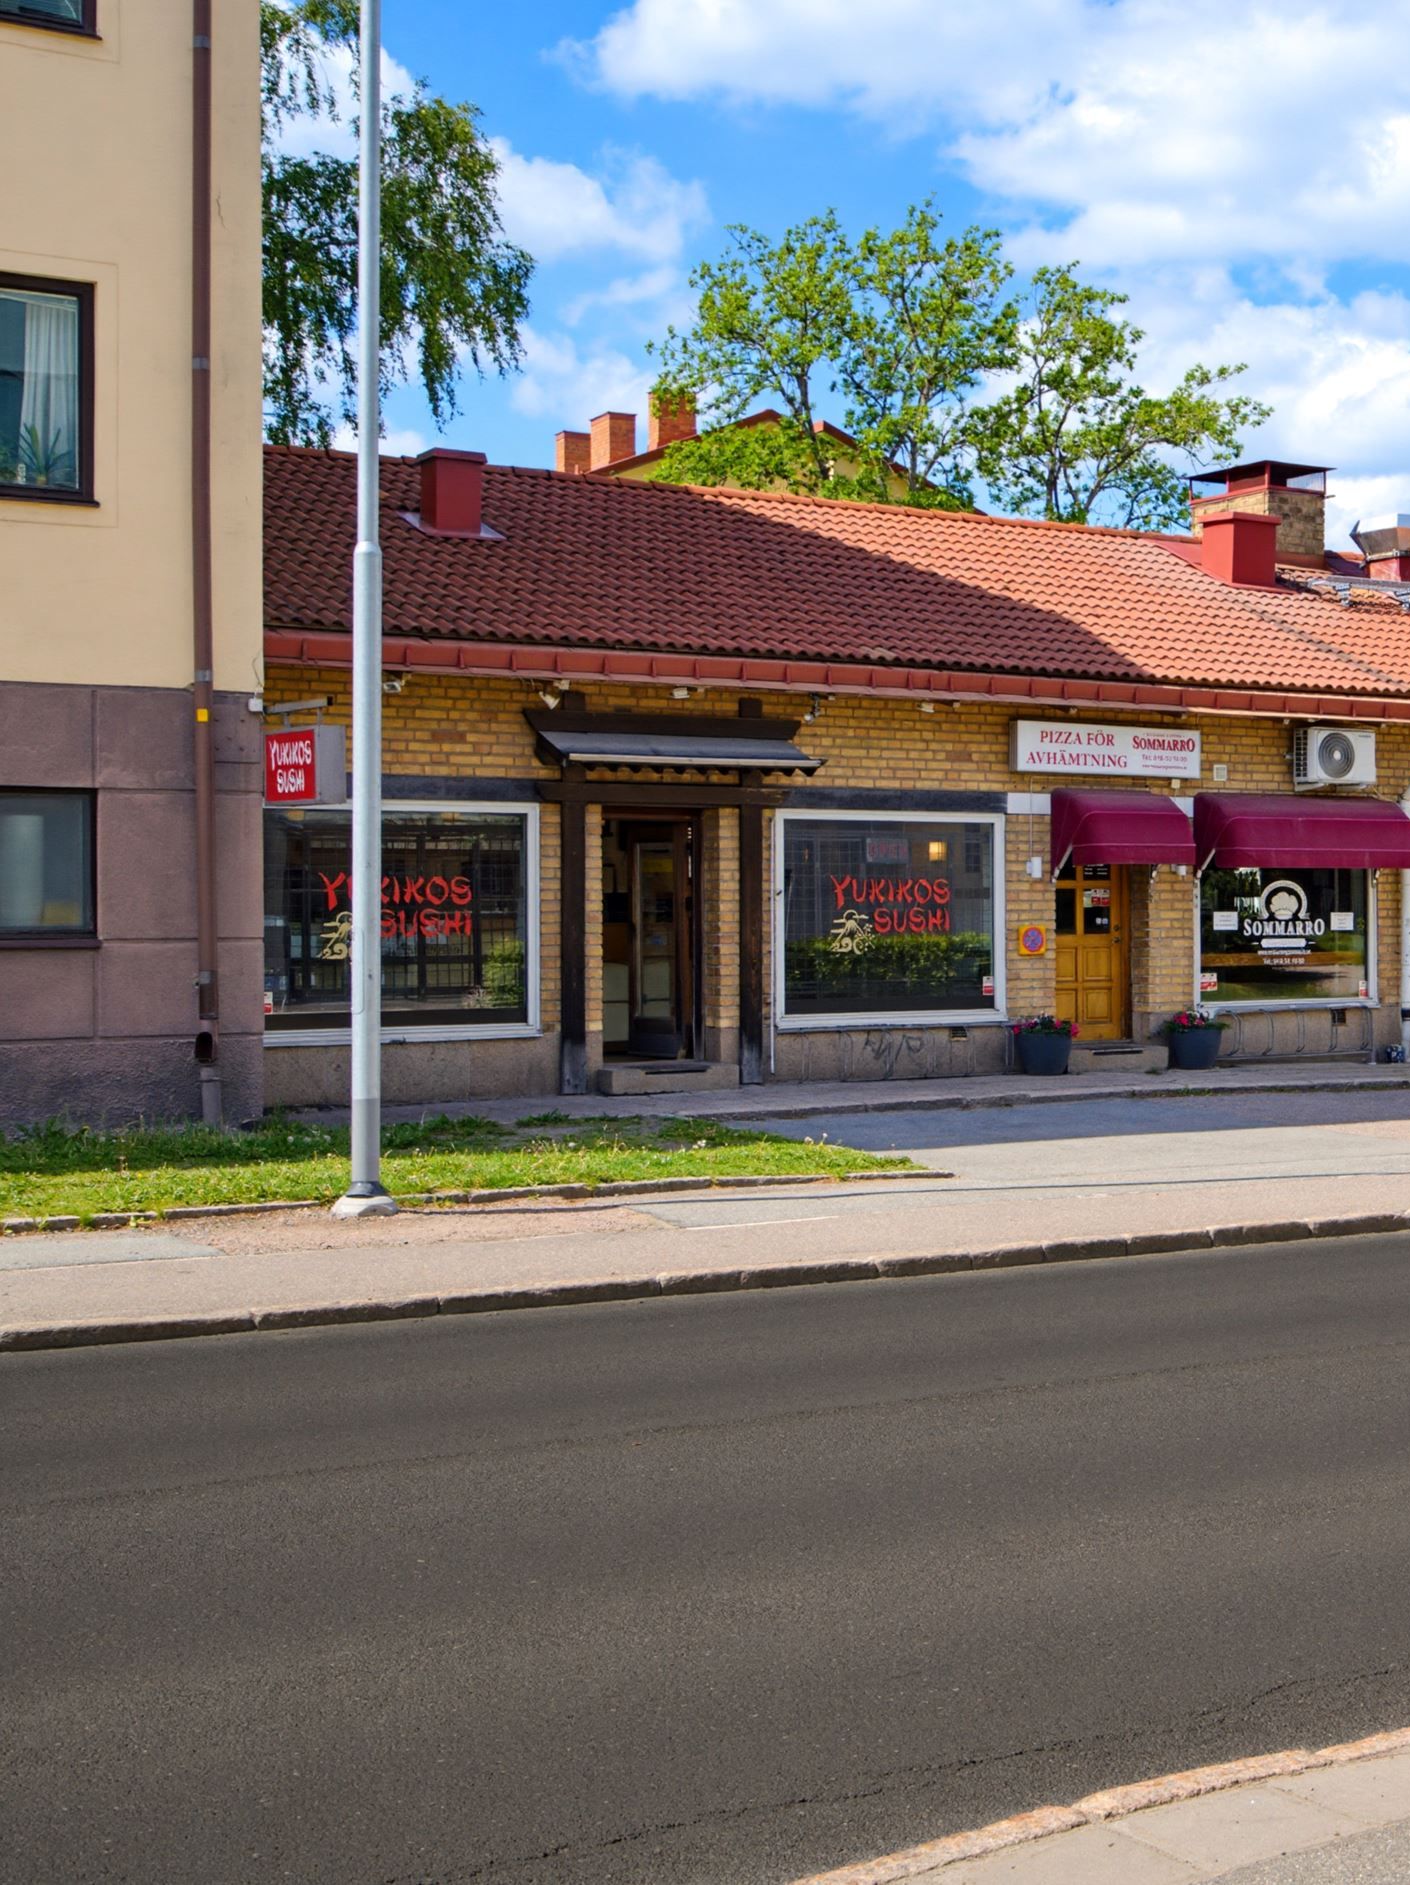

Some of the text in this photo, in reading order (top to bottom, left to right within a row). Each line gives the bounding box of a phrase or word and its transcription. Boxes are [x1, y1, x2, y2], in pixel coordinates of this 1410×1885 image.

[1040, 729, 1115, 746] PIZZA FÖR
[1132, 735, 1196, 752] SOMMARRO
[268, 739, 312, 771] YUKIKOS
[1026, 749, 1128, 768] AVHÄMTNING
[277, 768, 305, 793] SUSHI
[318, 871, 472, 912] YIKOS
[831, 875, 951, 910] YUKIKOS
[381, 908, 472, 938] SUSHI
[874, 907, 950, 934] SUSHI
[1243, 918, 1325, 936] SOMMARRO
